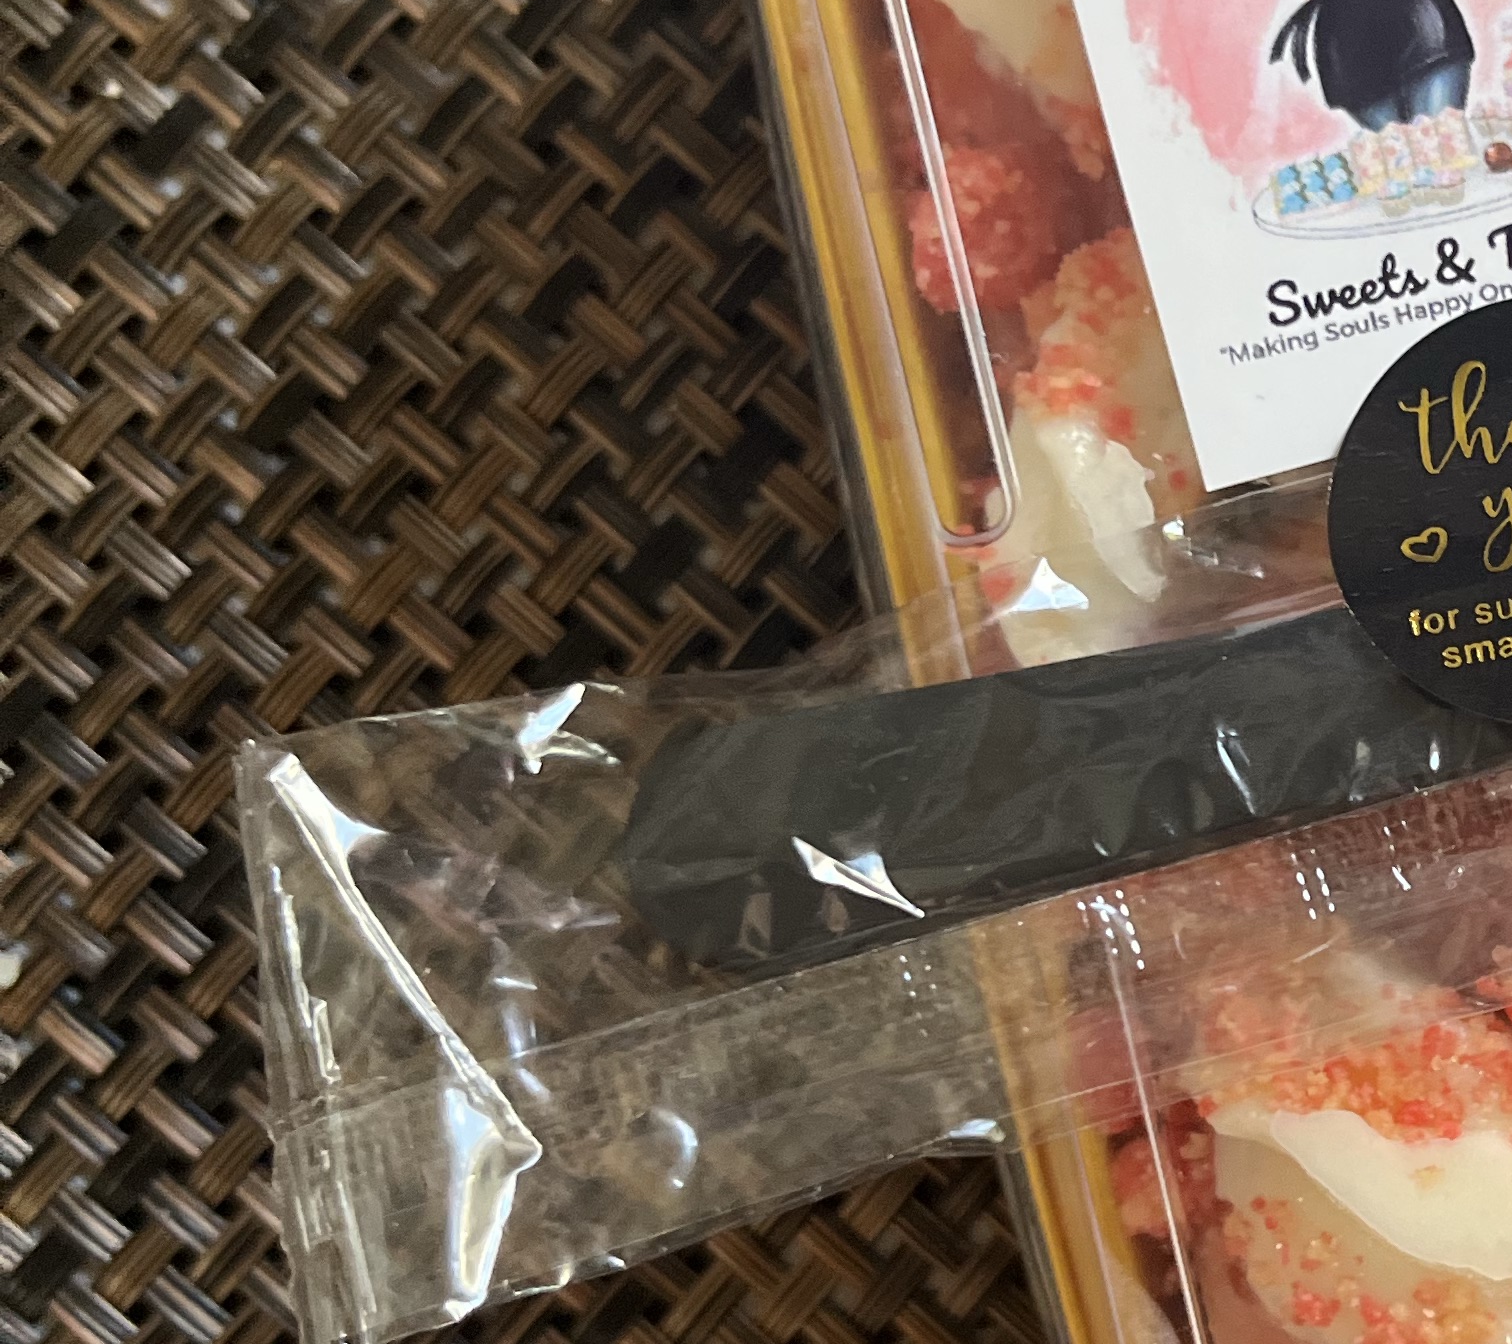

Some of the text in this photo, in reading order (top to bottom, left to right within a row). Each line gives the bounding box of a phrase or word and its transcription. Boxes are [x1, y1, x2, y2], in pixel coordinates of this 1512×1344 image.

[1266, 253, 1429, 327] Sweets
[1435, 237, 1476, 285] &
[1325, 311, 1390, 342] Souls
[1395, 291, 1474, 321] Happy
[1408, 608, 1460, 637] for
